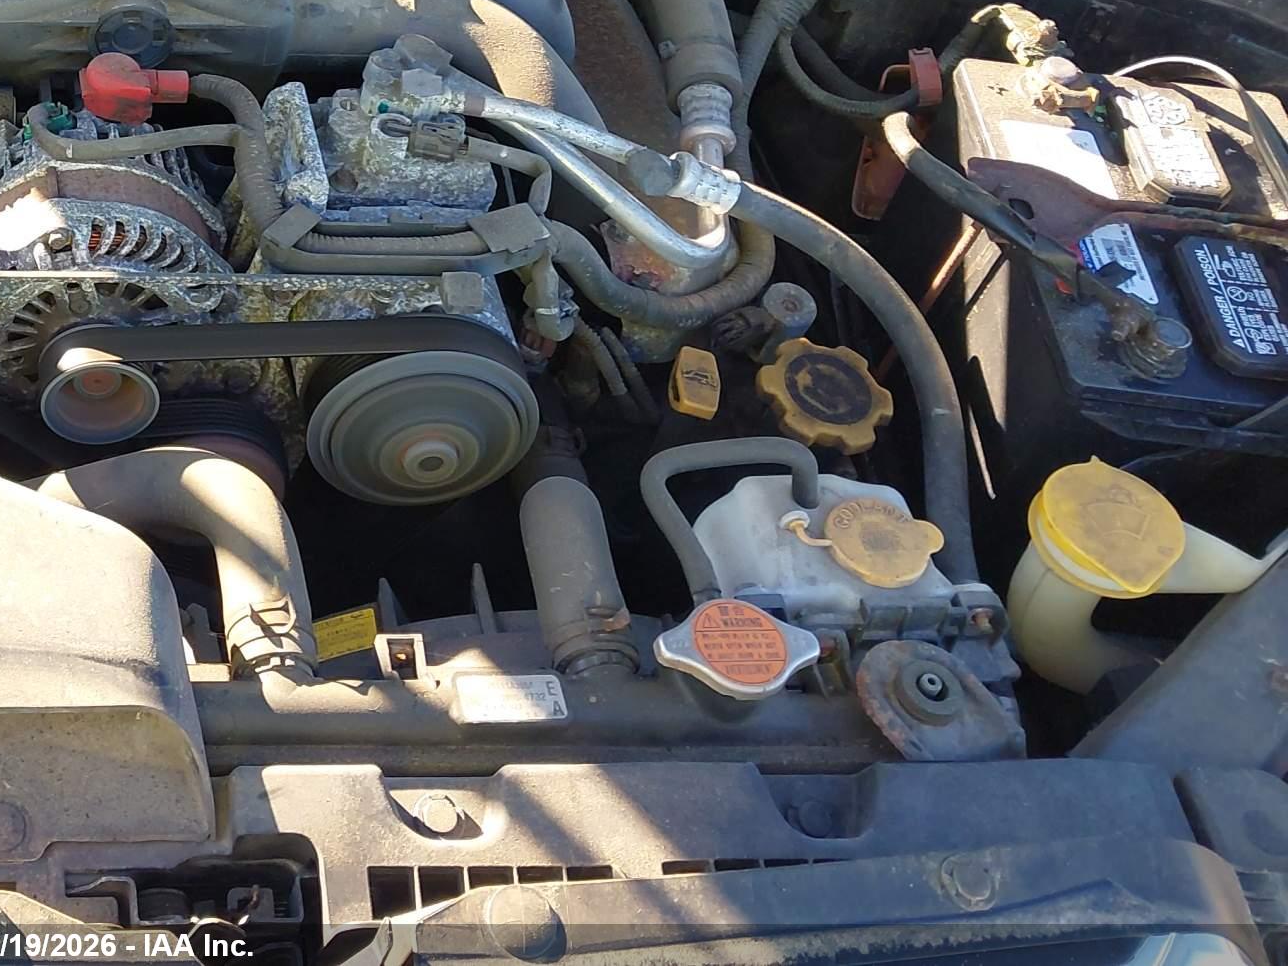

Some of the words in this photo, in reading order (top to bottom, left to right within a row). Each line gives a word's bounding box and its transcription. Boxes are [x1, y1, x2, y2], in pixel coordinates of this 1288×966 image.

[1194, 249, 1216, 286] POISON
[1214, 295, 1241, 338] DANGER
[720, 617, 762, 628] WARNING
